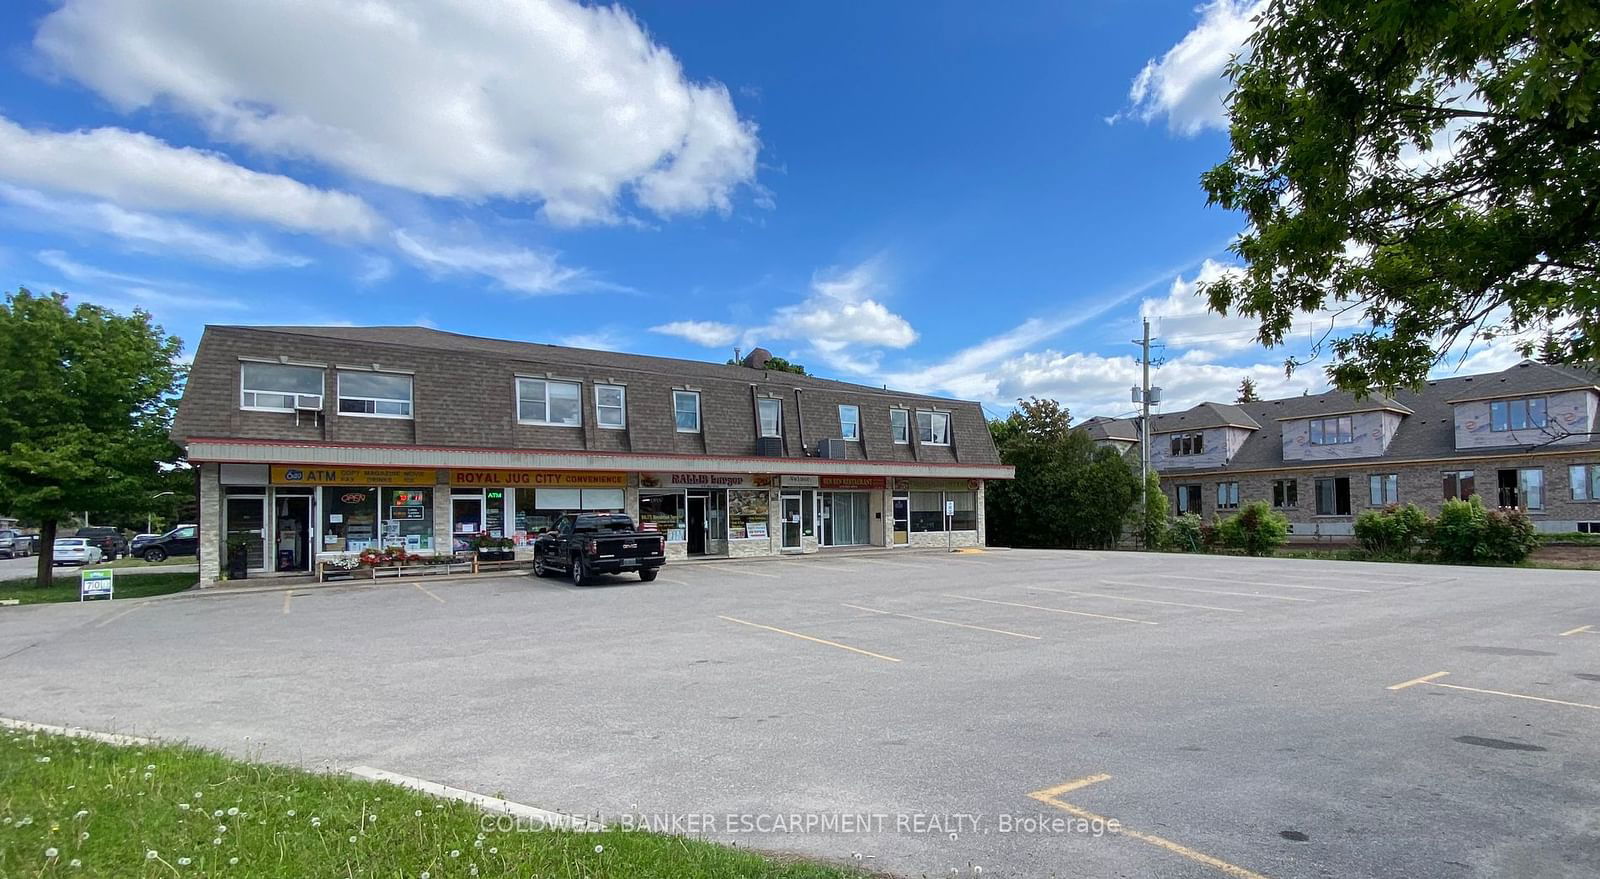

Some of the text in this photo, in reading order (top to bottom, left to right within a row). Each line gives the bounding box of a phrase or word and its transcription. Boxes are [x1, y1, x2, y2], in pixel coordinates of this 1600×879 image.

[307, 471, 336, 481] ATM
[456, 473, 622, 484] ROYAL JUG CITY CONVENIENCE
[341, 493, 366, 504] OPEN
